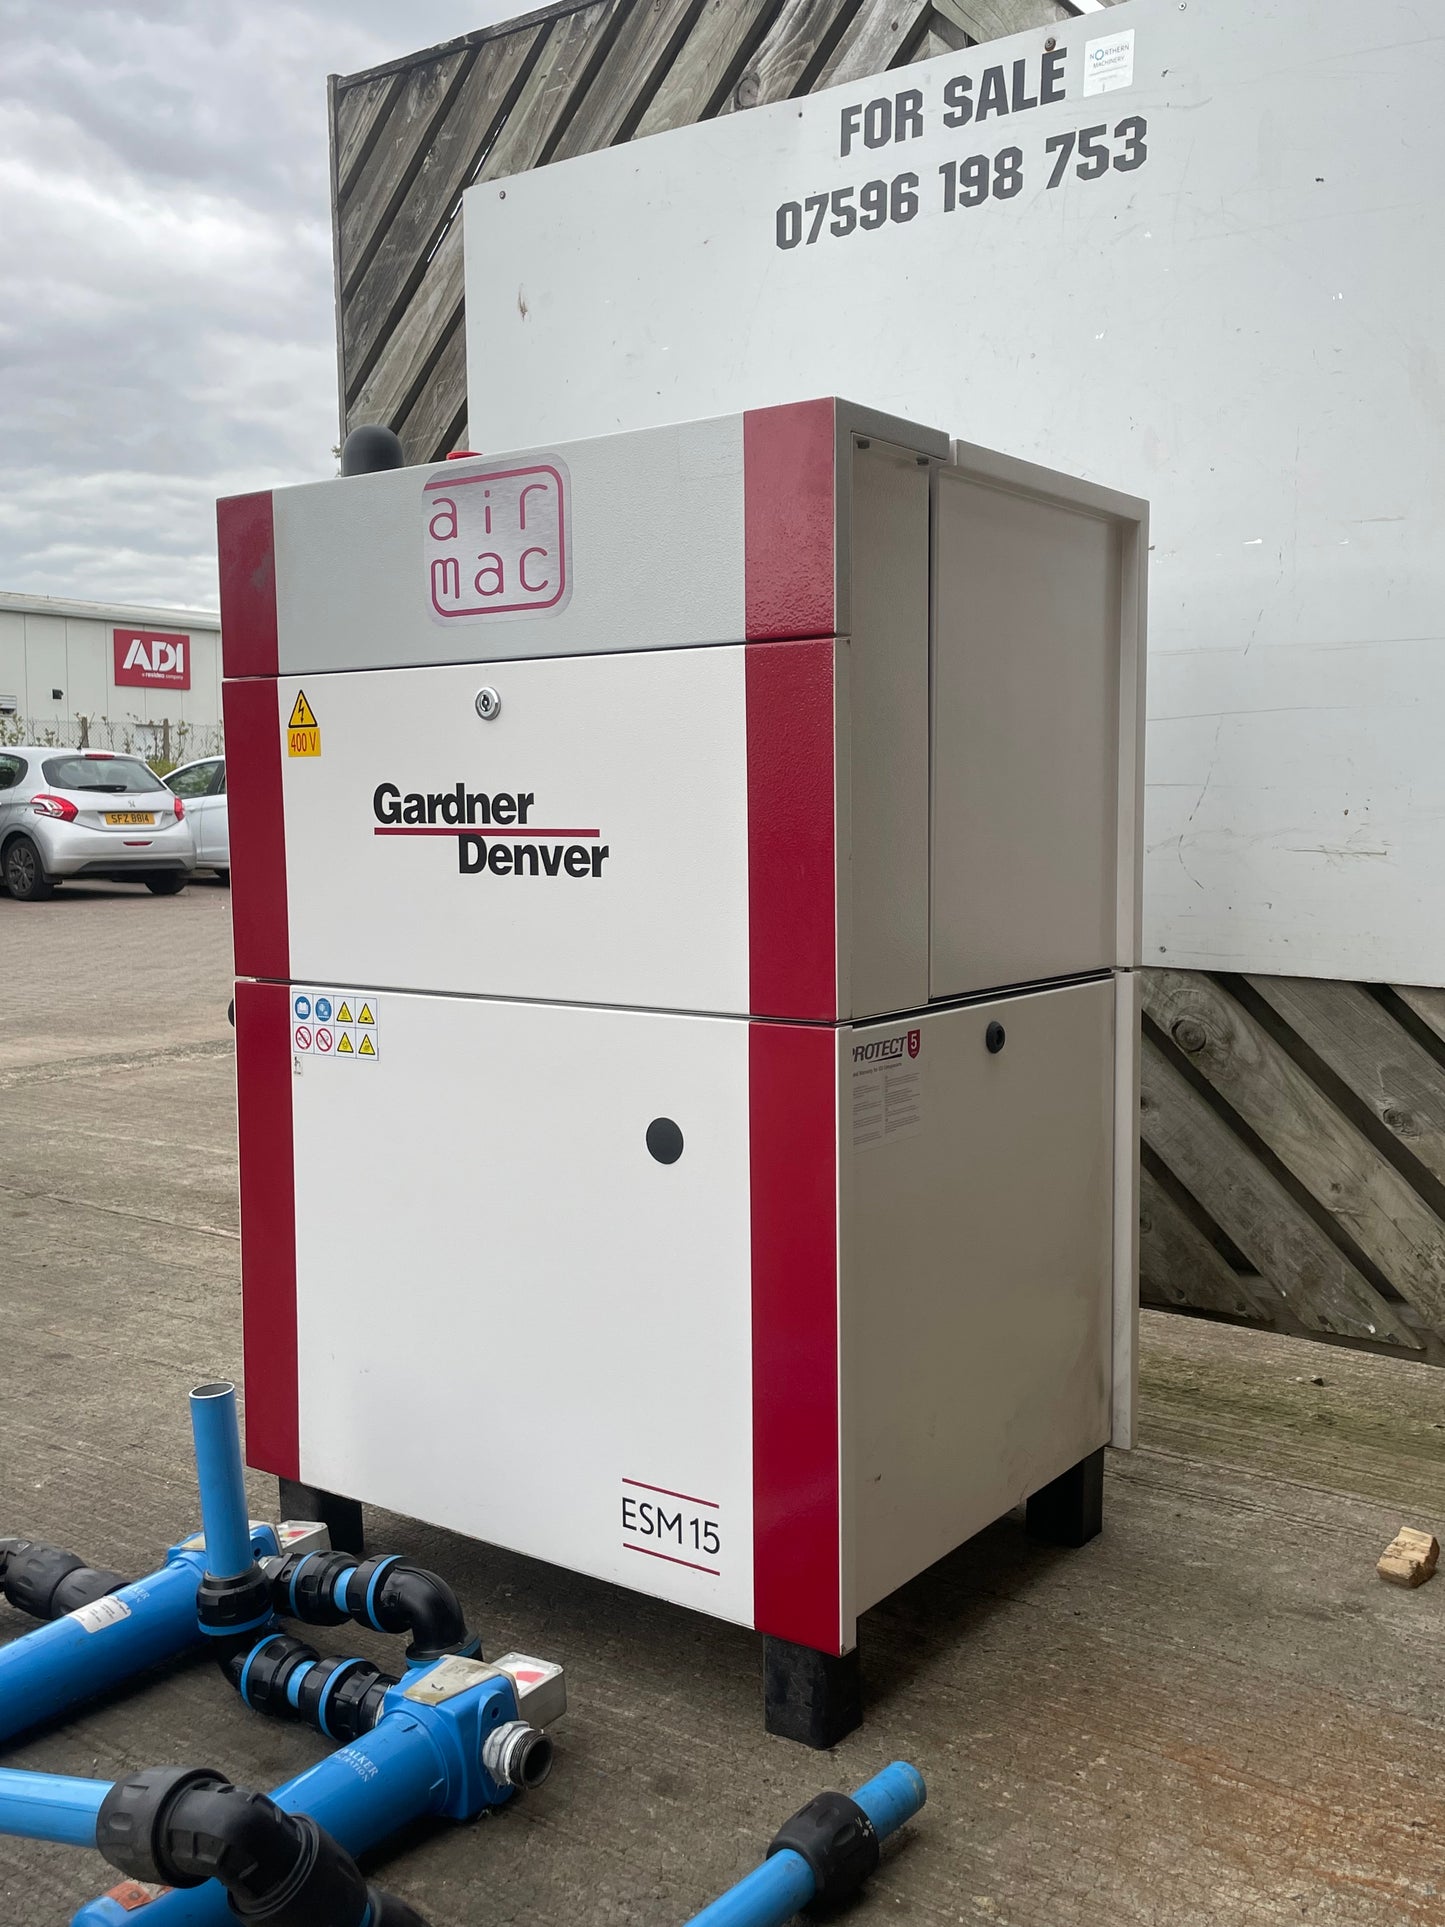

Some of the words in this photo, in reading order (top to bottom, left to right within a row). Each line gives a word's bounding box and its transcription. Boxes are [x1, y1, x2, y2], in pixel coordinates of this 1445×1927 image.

[1089, 44, 1130, 61] NORTHERN
[1093, 56, 1125, 69] MACHINERY
[840, 88, 924, 157] FOR
[943, 47, 1067, 129] SALE
[775, 171, 920, 250] 07596
[939, 146, 1023, 213] 198
[1045, 115, 1148, 190] 753
[429, 484, 549, 541] air
[431, 547, 549, 600] mac
[122, 639, 184, 673] ADI
[290, 732, 307, 752] 400
[309, 731, 317, 751] V
[111, 813, 129, 823] SFZ
[131, 813, 150, 823] 8814
[373, 782, 534, 825] Gardner
[458, 833, 609, 878] Denver
[853, 1036, 907, 1062] ROTECT
[910, 1033, 917, 1050] 5
[622, 1497, 682, 1545] ESM
[690, 1518, 720, 1554] 15
